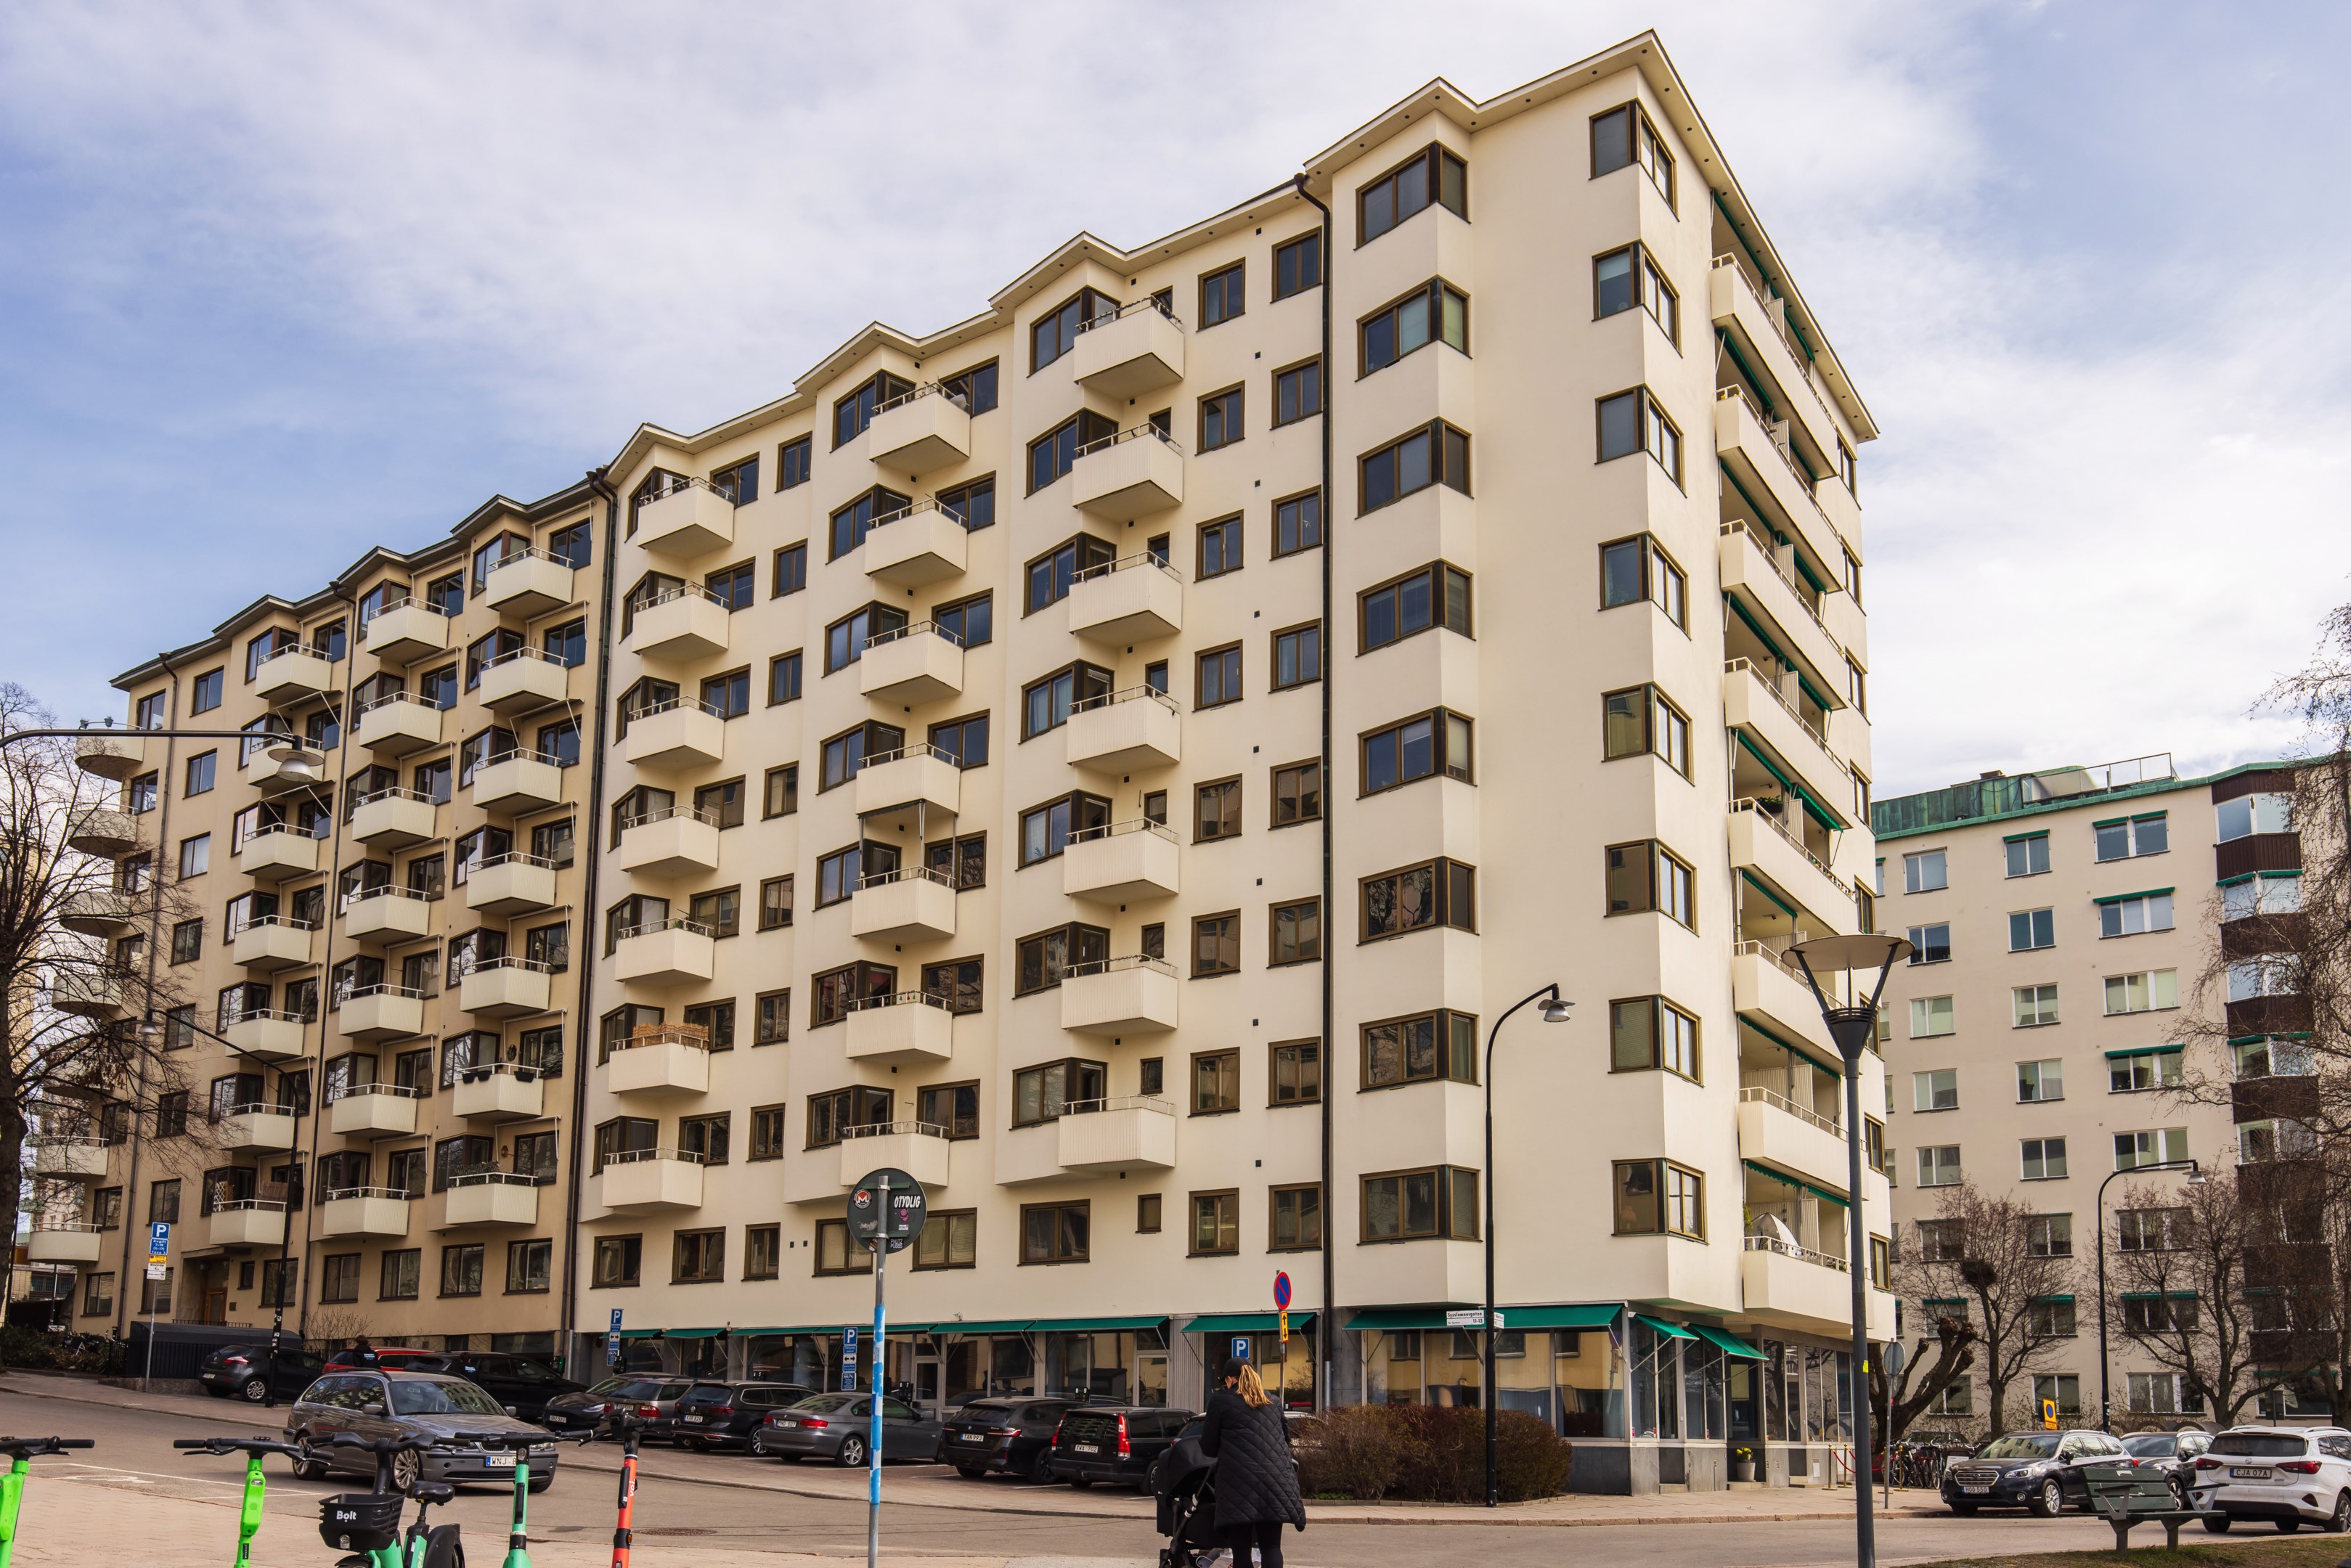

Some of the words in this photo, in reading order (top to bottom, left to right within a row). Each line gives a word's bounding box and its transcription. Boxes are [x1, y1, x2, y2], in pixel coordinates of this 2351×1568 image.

[156, 1224, 167, 1238] P
[613, 1310, 621, 1323] P
[847, 1329, 855, 1344] P
[1236, 1340, 1246, 1357] P
[336, 1511, 357, 1522] Bolt
